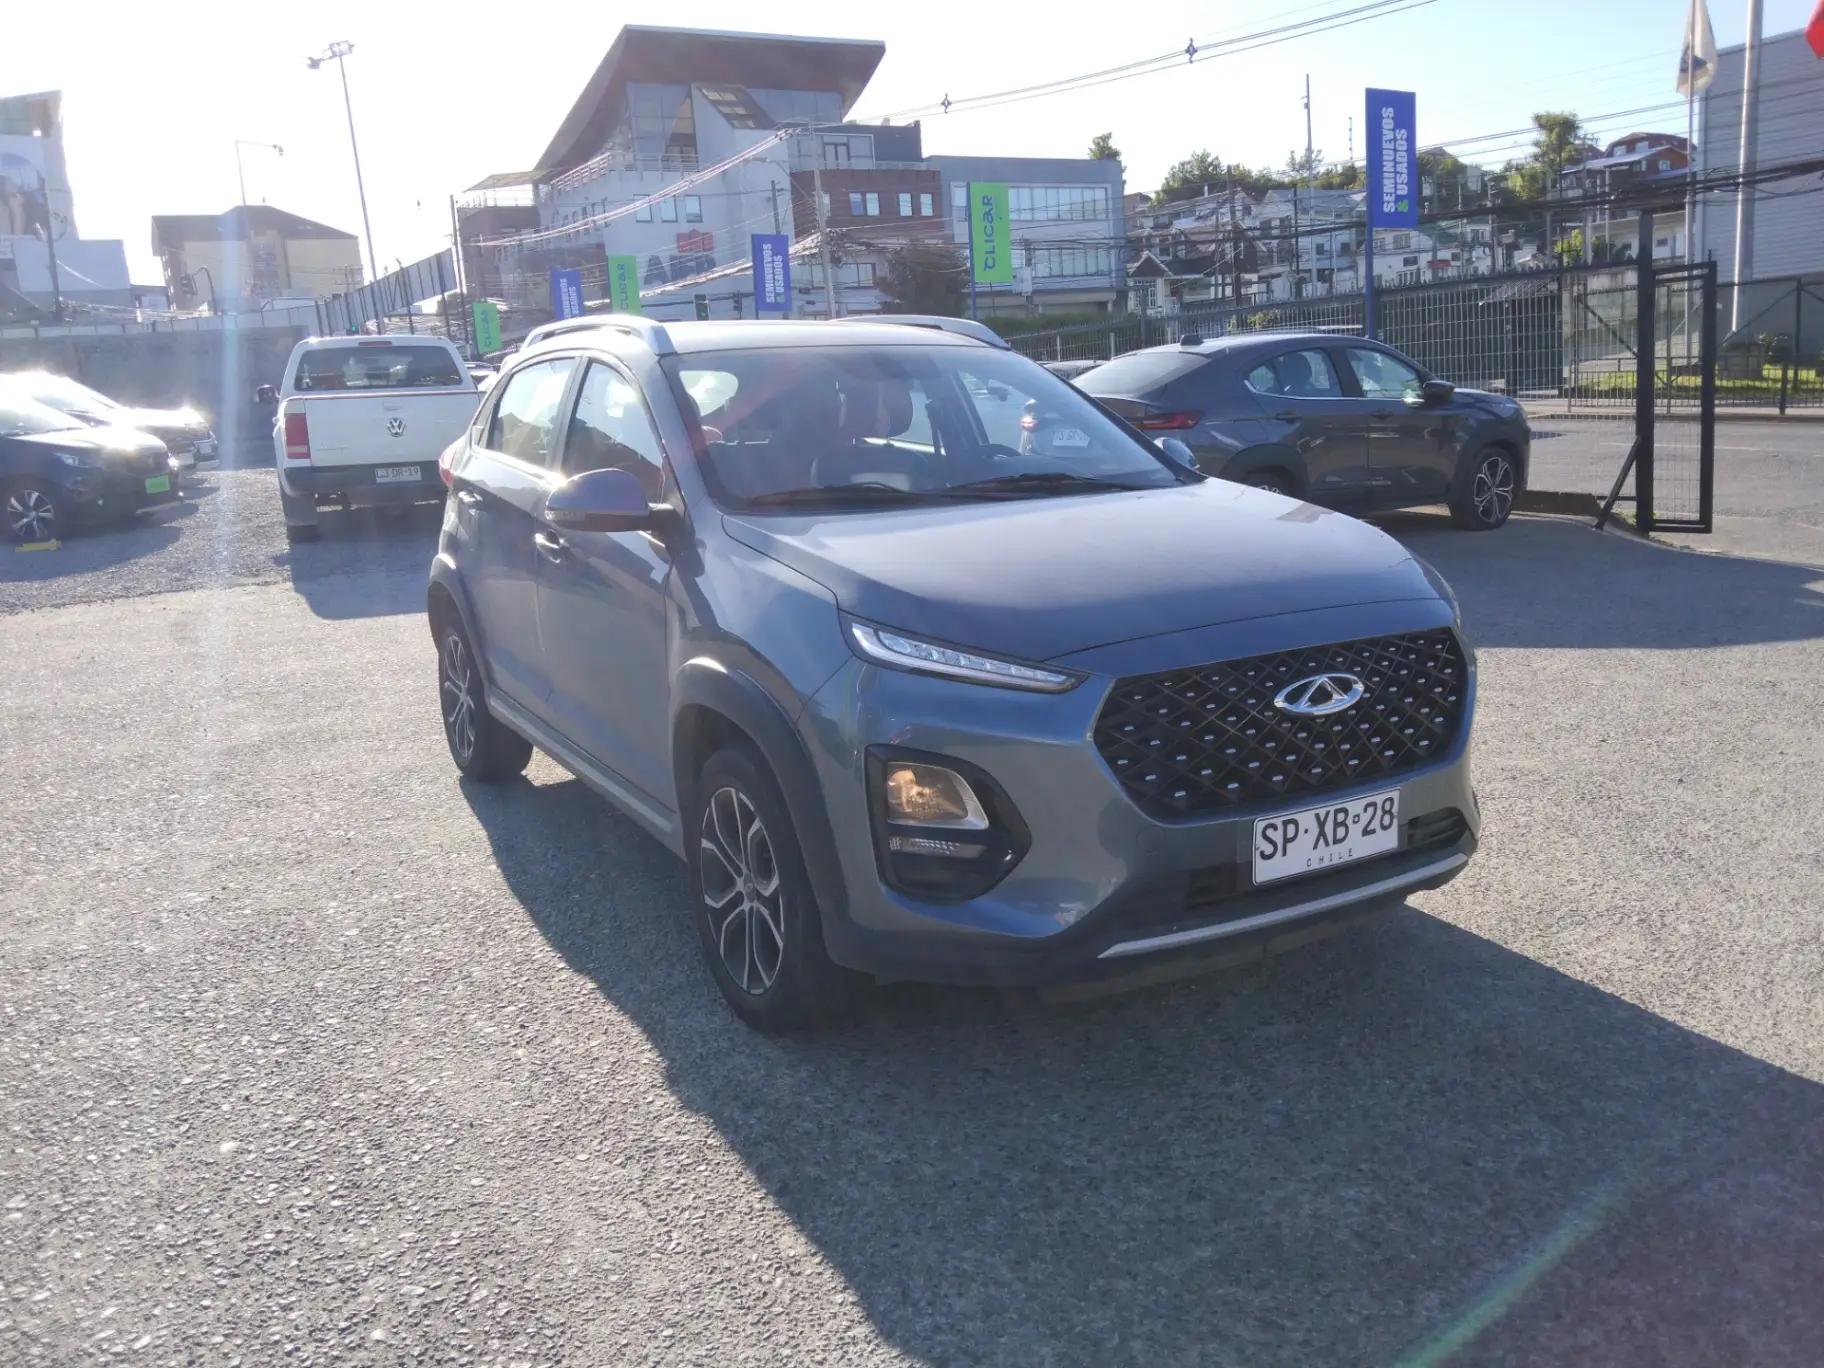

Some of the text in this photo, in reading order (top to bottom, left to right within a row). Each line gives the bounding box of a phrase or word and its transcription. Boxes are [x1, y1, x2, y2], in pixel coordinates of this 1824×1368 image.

[1382, 106, 1396, 213] SEMINUEVOS
[1395, 128, 1409, 195] USADOS
[762, 243, 776, 304] SEMINUEVOS
[772, 255, 785, 293] USADOS
[1306, 848, 1353, 867] CHILE
